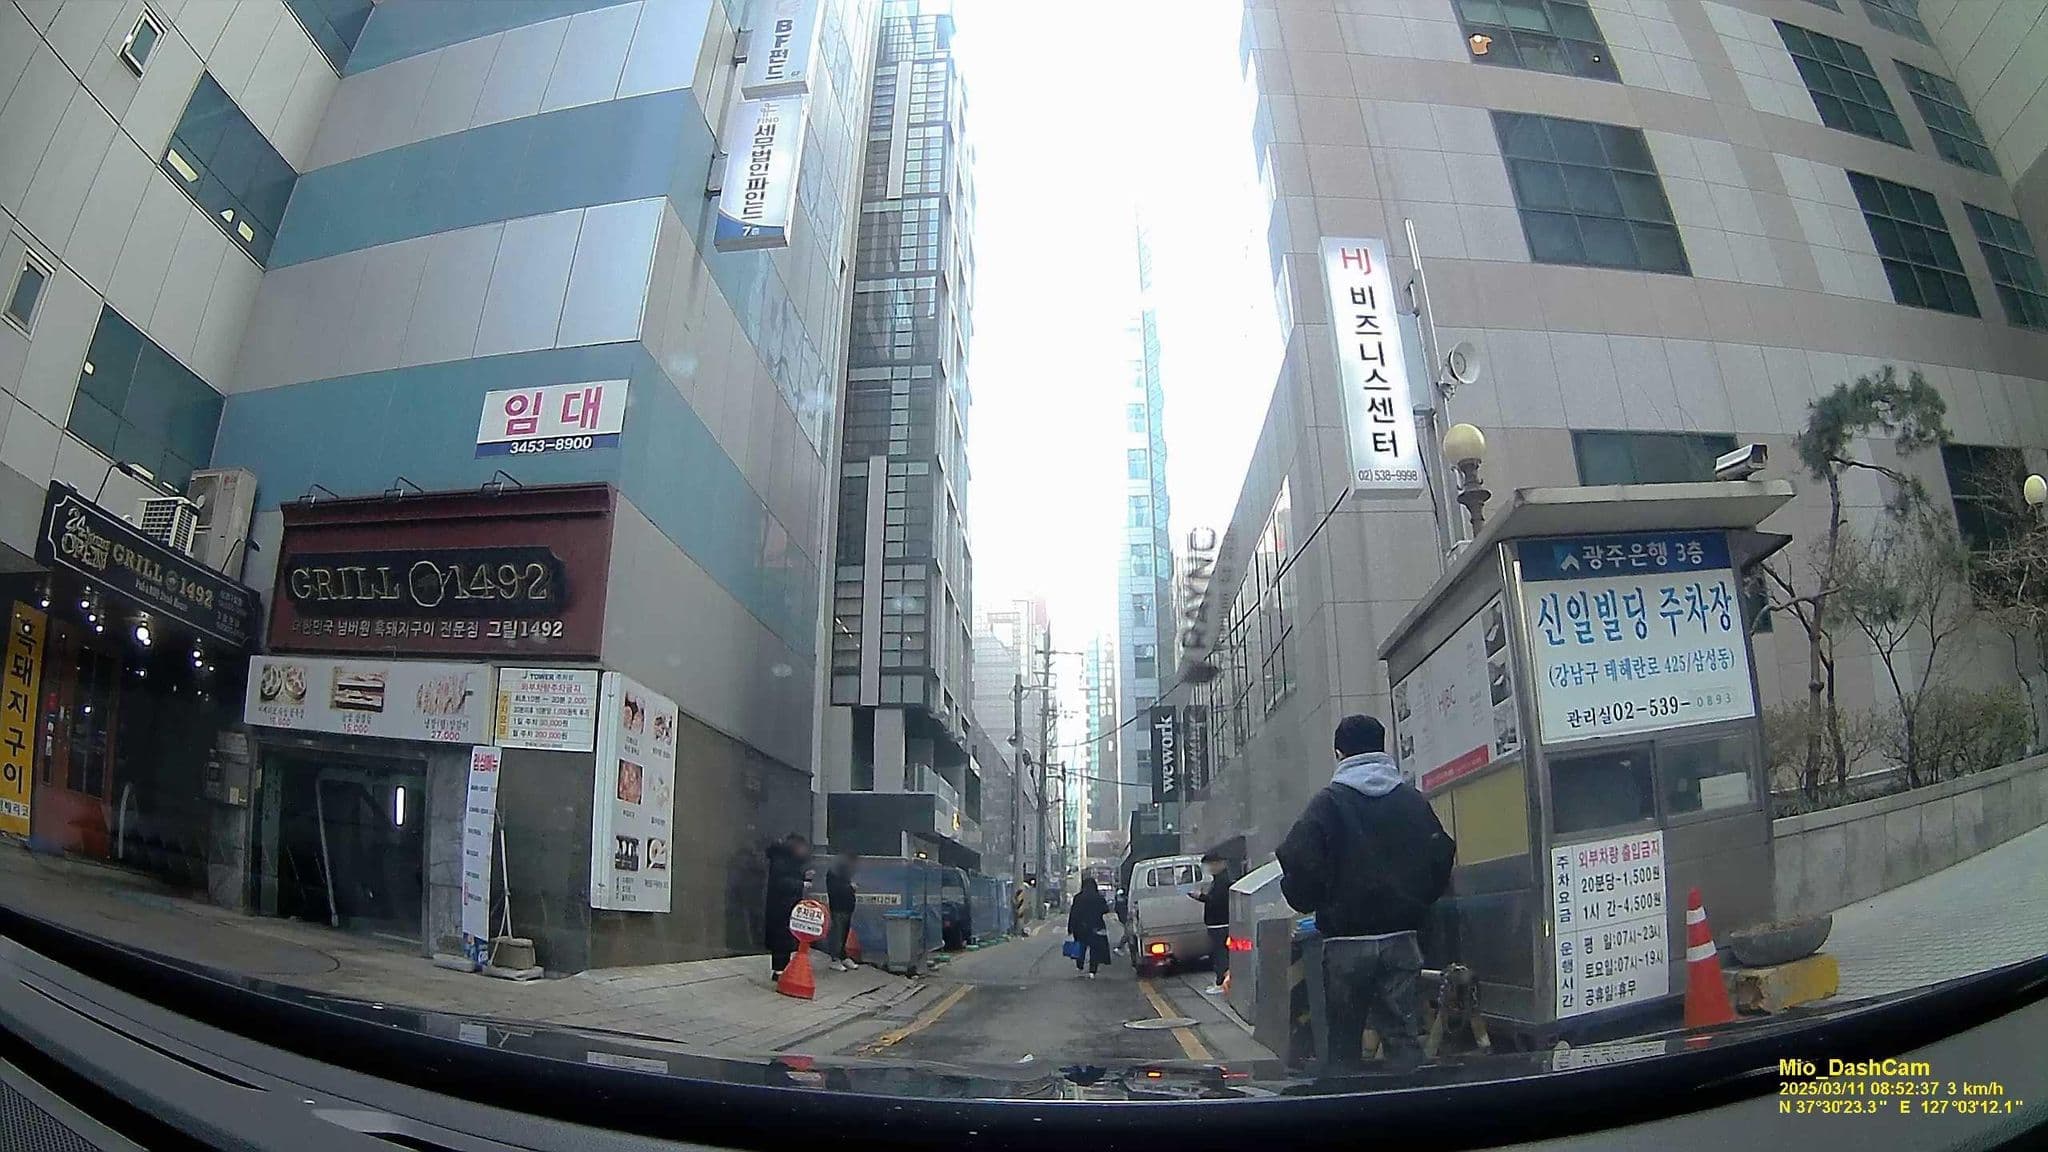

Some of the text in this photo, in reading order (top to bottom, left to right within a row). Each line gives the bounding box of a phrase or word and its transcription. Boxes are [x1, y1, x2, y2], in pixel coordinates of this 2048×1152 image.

[741, 124, 777, 220] 세무법인파인드
[1341, 248, 1373, 275] HJ
[1349, 286, 1399, 458] 비즈니스센터
[509, 436, 593, 454] 3453-8900
[1583, 541, 1704, 570] 광주은행 3층
[113, 543, 163, 581] GRILL
[179, 576, 215, 610] 1492
[290, 563, 547, 601] GRILL 1492
[291, 619, 563, 639] 대한민국 넘버원 흑돼지구이 전문점 그릴1492
[1537, 580, 1733, 647] 신일빌딩 주차장
[1549, 647, 1736, 690] (강남구 테헤란로 425/삼성동)
[1154, 714, 1175, 794] wework
[1578, 838, 1660, 868] 외부차량 출입금지
[1585, 979, 1637, 1007] 공휴일:휴무
